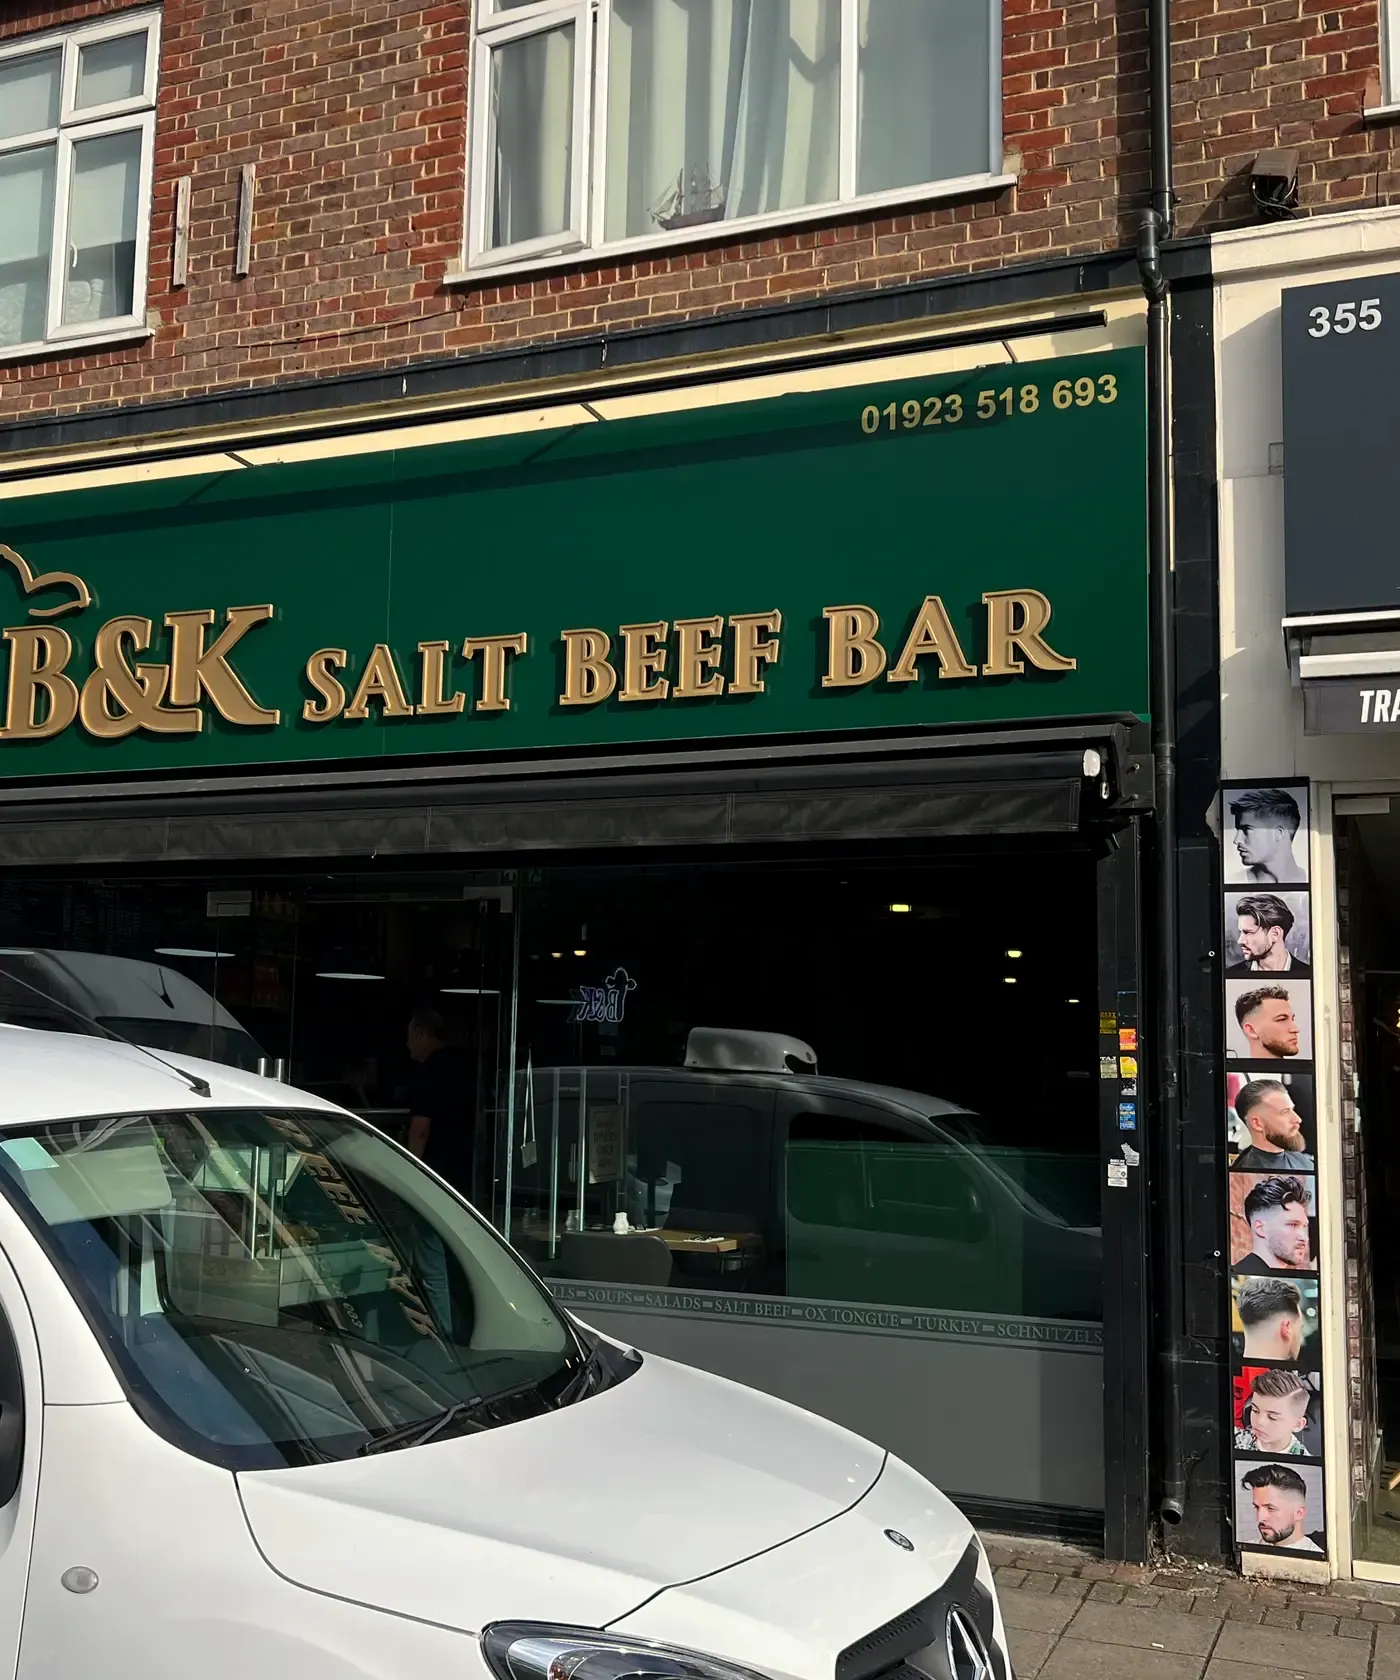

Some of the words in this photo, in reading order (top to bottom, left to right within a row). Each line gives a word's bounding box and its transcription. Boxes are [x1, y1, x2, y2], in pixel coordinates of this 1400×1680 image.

[1307, 298, 1382, 339] 355
[860, 393, 964, 435] 01923
[976, 384, 1039, 421] 518
[1051, 373, 1118, 411] 693
[0, 604, 280, 739] B&K
[302, 632, 528, 723] SALT
[558, 608, 782, 708] BEEF
[821, 588, 1077, 689] BAR
[1359, 689, 1400, 724] TRA
[552, 1285, 576, 1299] LLS
[587, 1288, 633, 1304] SOUPS
[645, 1293, 701, 1310] SALADS
[714, 1299, 751, 1314] SALT
[754, 1302, 791, 1317] BEEF
[805, 1306, 828, 1321] OX
[831, 1309, 900, 1328] TONGUE
[914, 1315, 981, 1334] TURKEY
[997, 1323, 1103, 1344] SCHNITZELS
